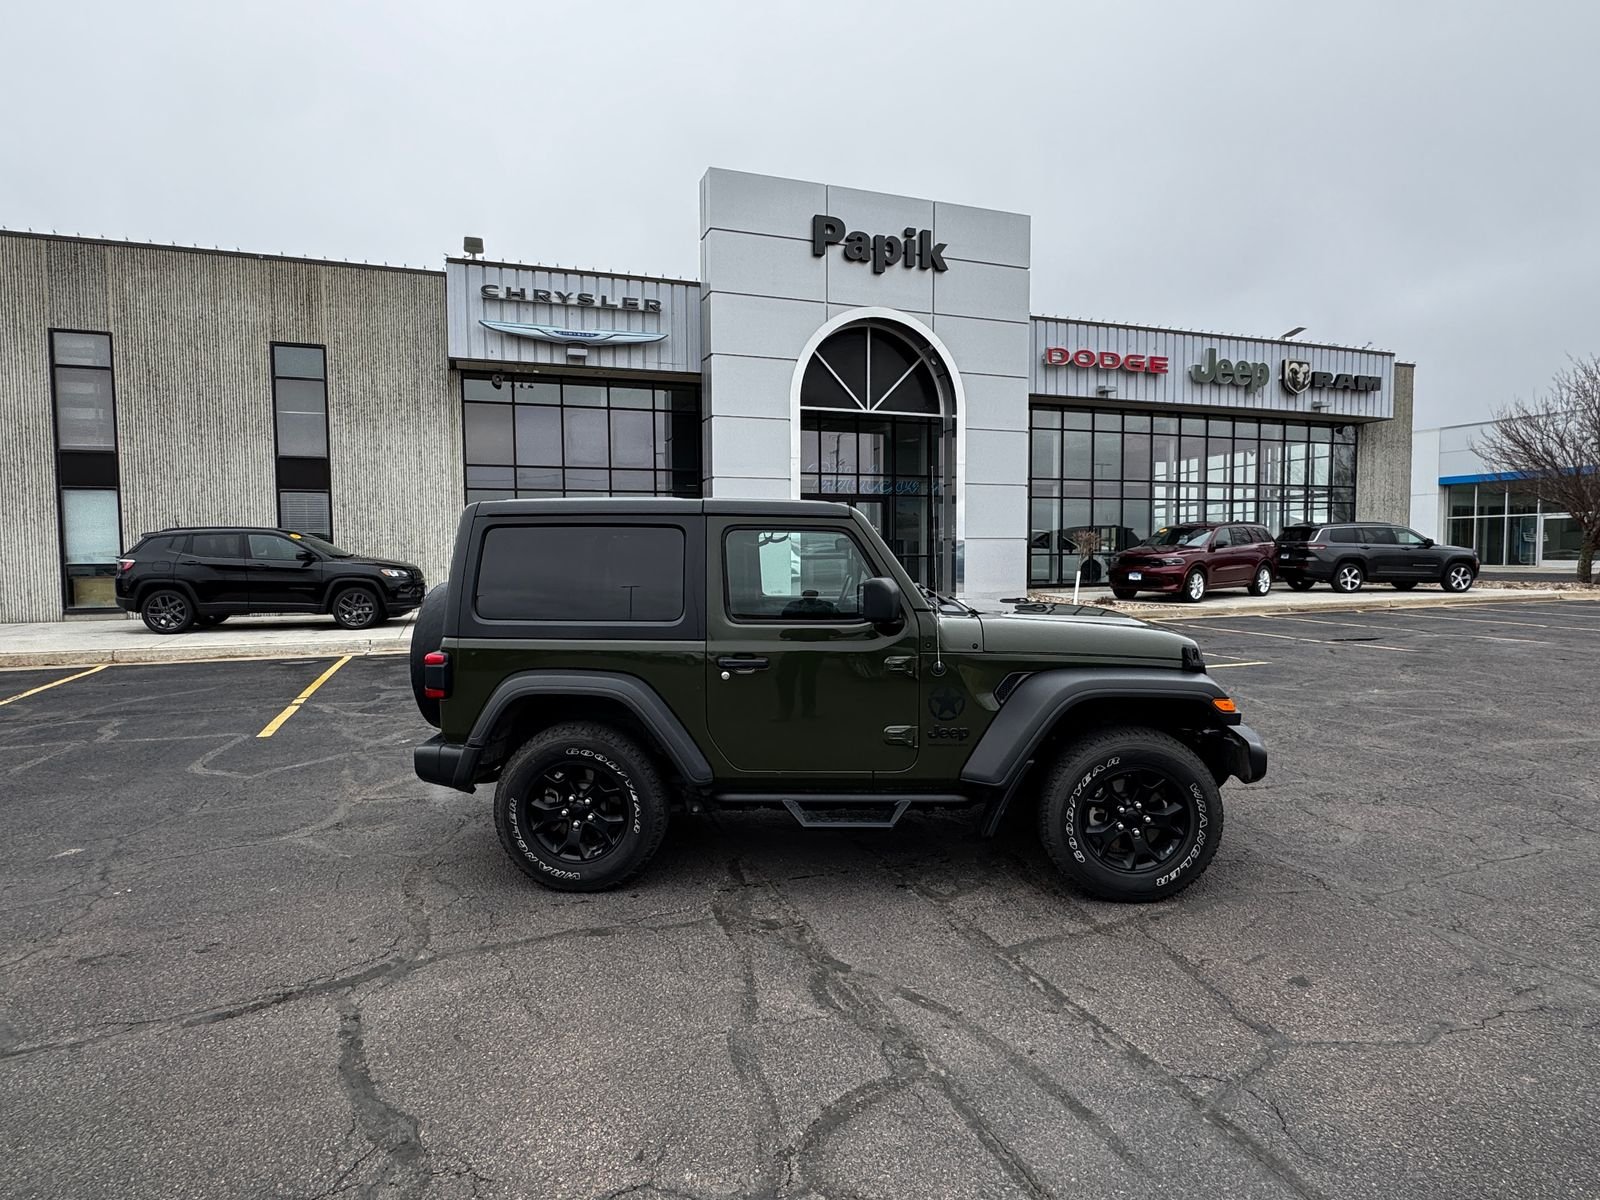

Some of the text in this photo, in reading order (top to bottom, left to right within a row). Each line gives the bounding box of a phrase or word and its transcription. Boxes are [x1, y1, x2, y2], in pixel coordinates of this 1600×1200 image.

[813, 214, 949, 273] Papik
[480, 283, 663, 313] CHRYSLER
[1044, 347, 1168, 375] DODGE
[1192, 348, 1270, 393] Jeep
[1311, 372, 1382, 392] RAM
[928, 725, 970, 741] Jeep
[565, 747, 641, 834] GOODYEAR
[1065, 756, 1121, 863] GOODYEAR
[508, 797, 581, 880] WRANGLER
[1155, 782, 1209, 887] WRANGLER
